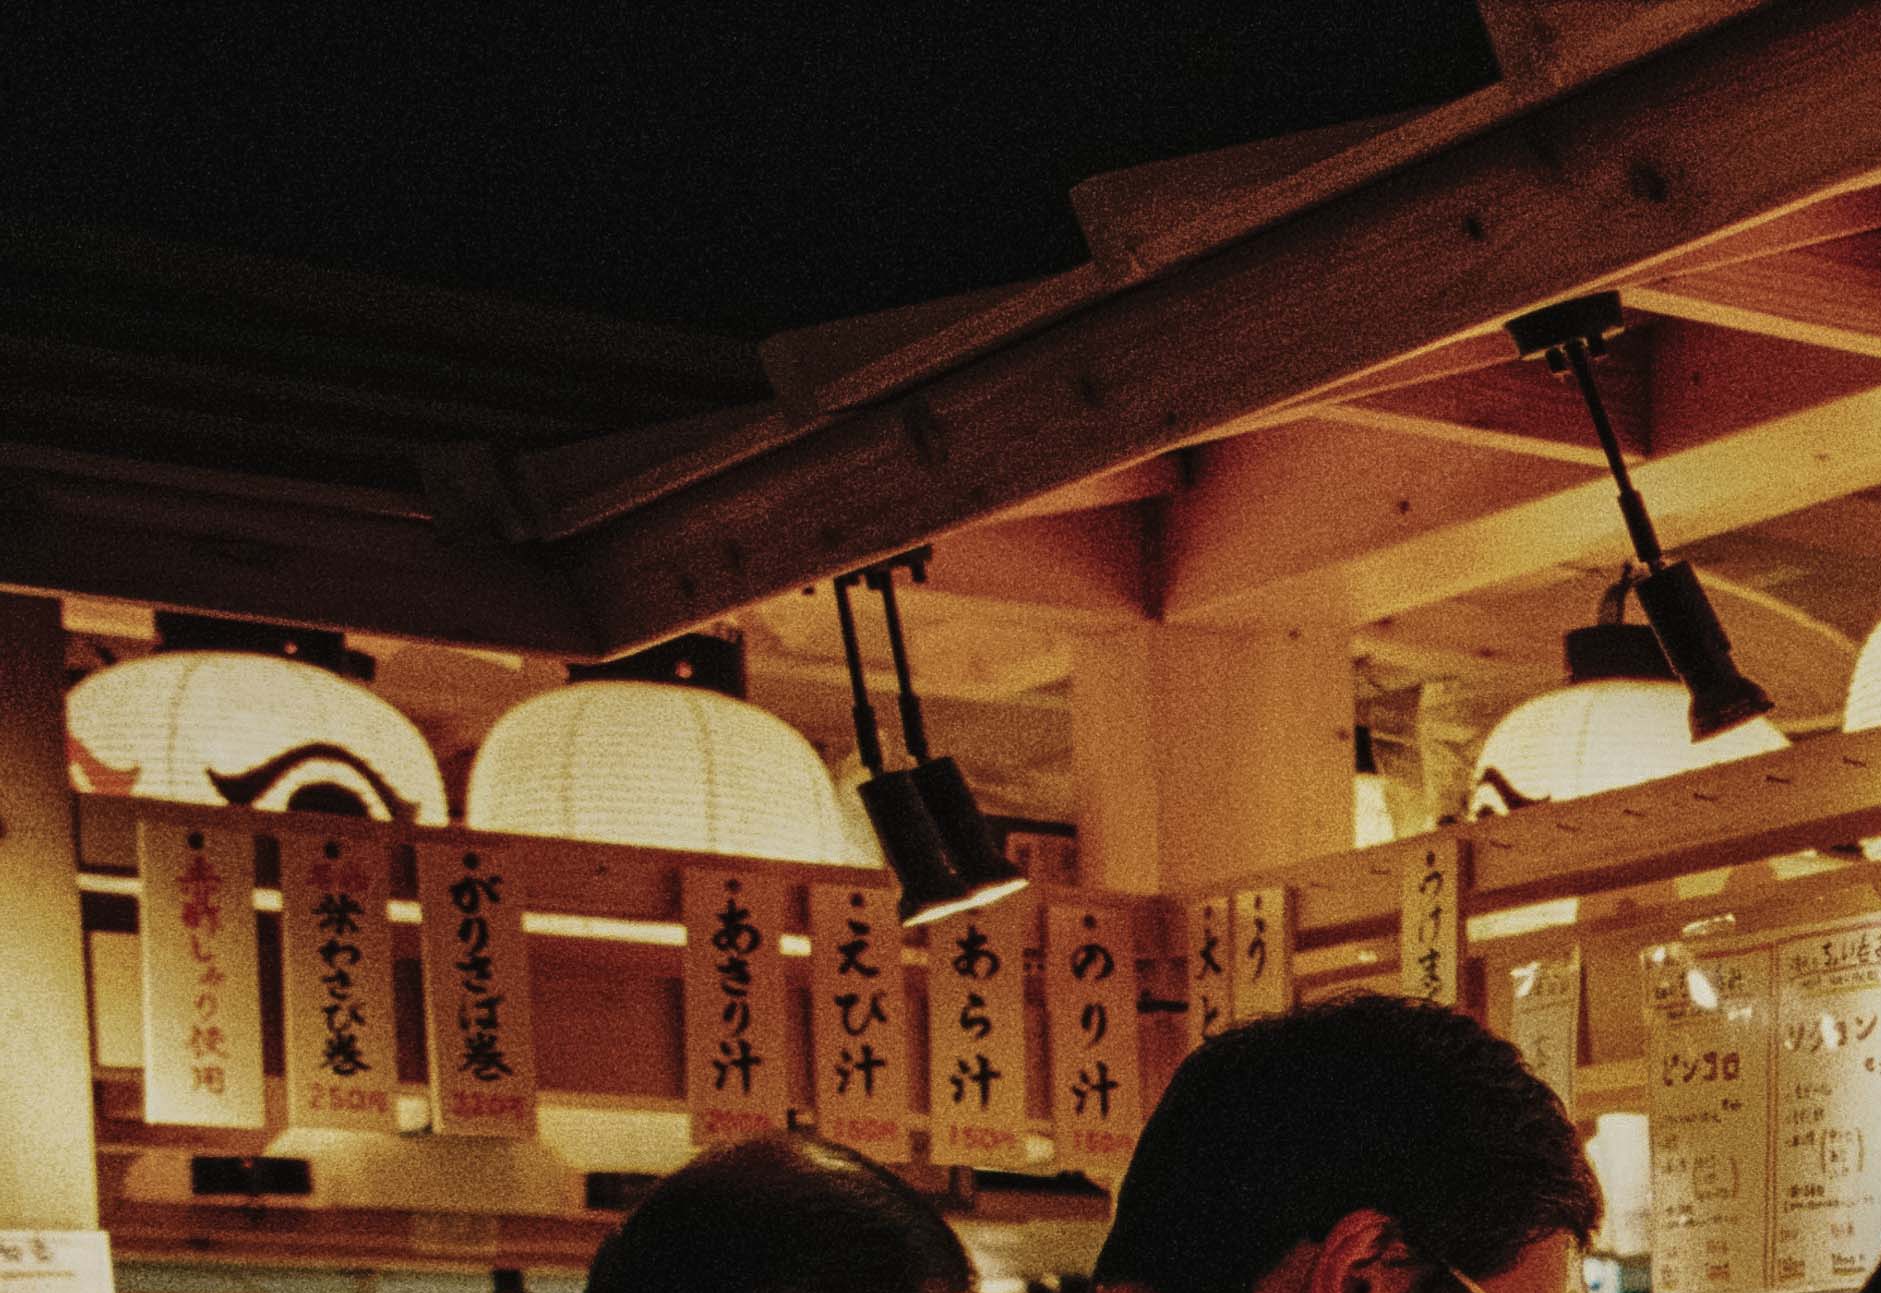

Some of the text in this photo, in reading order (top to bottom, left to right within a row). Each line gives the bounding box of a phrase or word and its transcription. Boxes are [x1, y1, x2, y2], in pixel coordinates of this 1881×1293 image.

[712, 898, 762, 1095] あさり汁
[833, 919, 888, 1098] えび汁
[949, 924, 1001, 1112] あら汁
[1070, 943, 1119, 1119] のり汁
